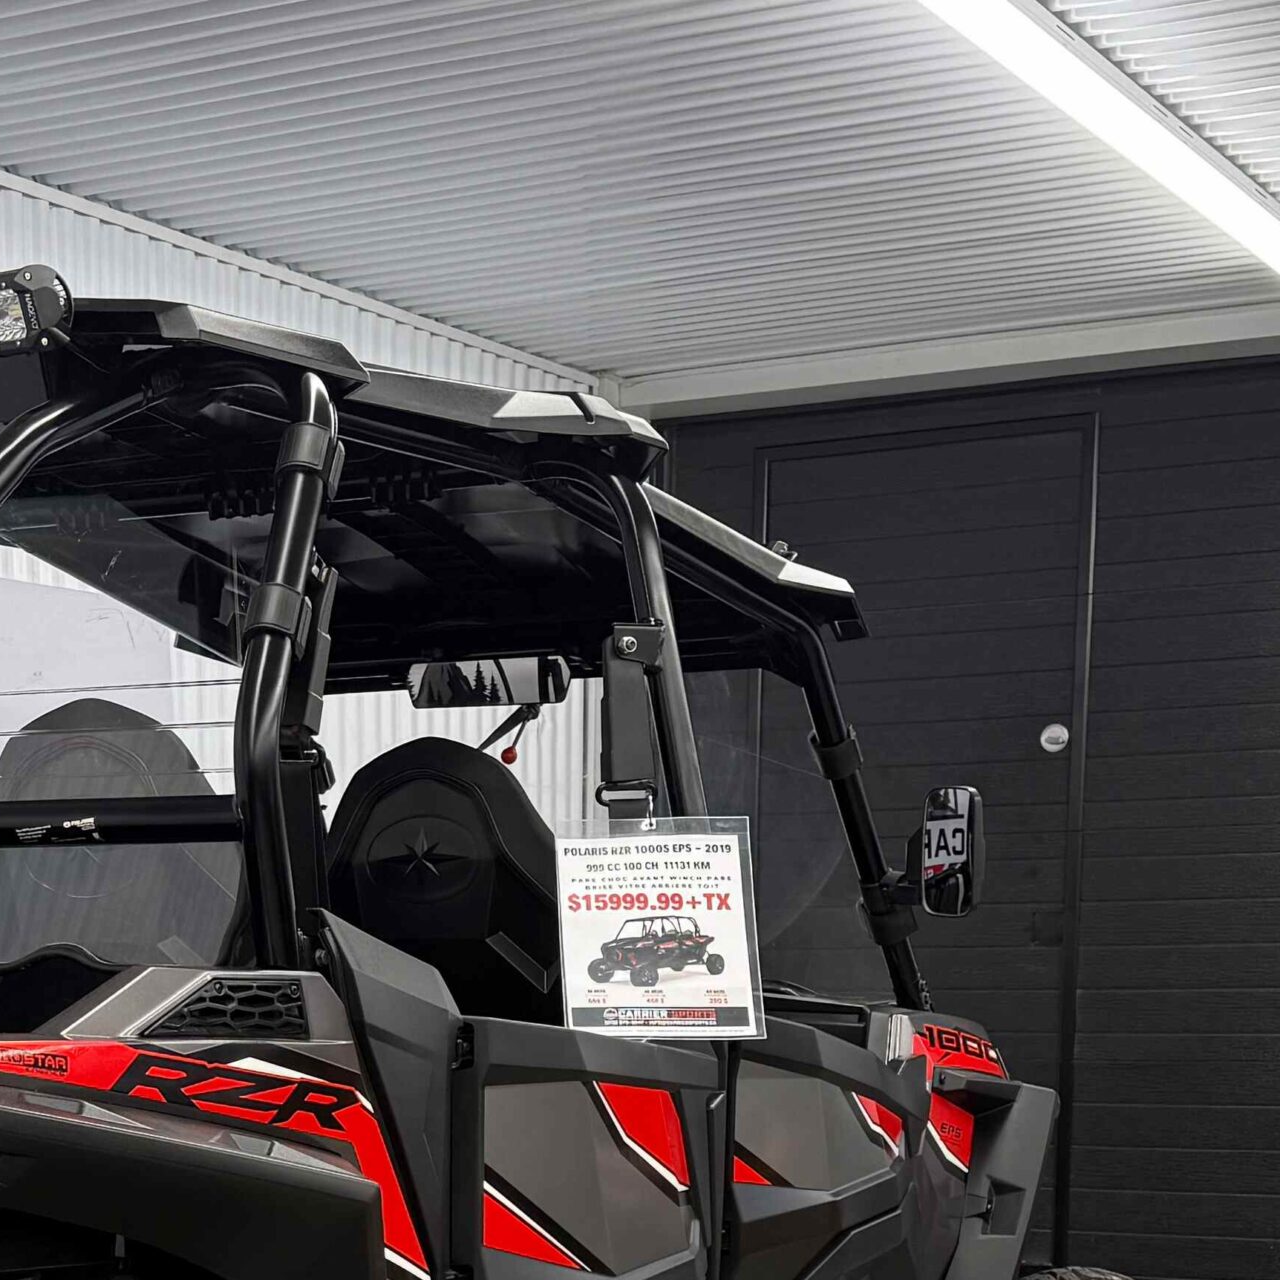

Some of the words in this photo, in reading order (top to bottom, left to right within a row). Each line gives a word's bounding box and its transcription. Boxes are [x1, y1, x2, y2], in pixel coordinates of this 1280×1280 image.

[564, 847, 609, 857] POLARIS
[611, 846, 631, 856] RZR
[635, 845, 669, 855] 1000S
[672, 844, 692, 853] EPS
[705, 843, 731, 853] 2019
[586, 863, 604, 872] 999
[608, 863, 621, 871] CC
[624, 862, 642, 871] 100
[645, 861, 658, 870] CH
[664, 861, 691, 870] 11131
[693, 861, 711, 869] KM
[567, 892, 732, 913] $15999.99+TX
[618, 1009, 668, 1019] CARRIER
[114, 1055, 360, 1131] RZR
[939, 1121, 962, 1139] EPS
